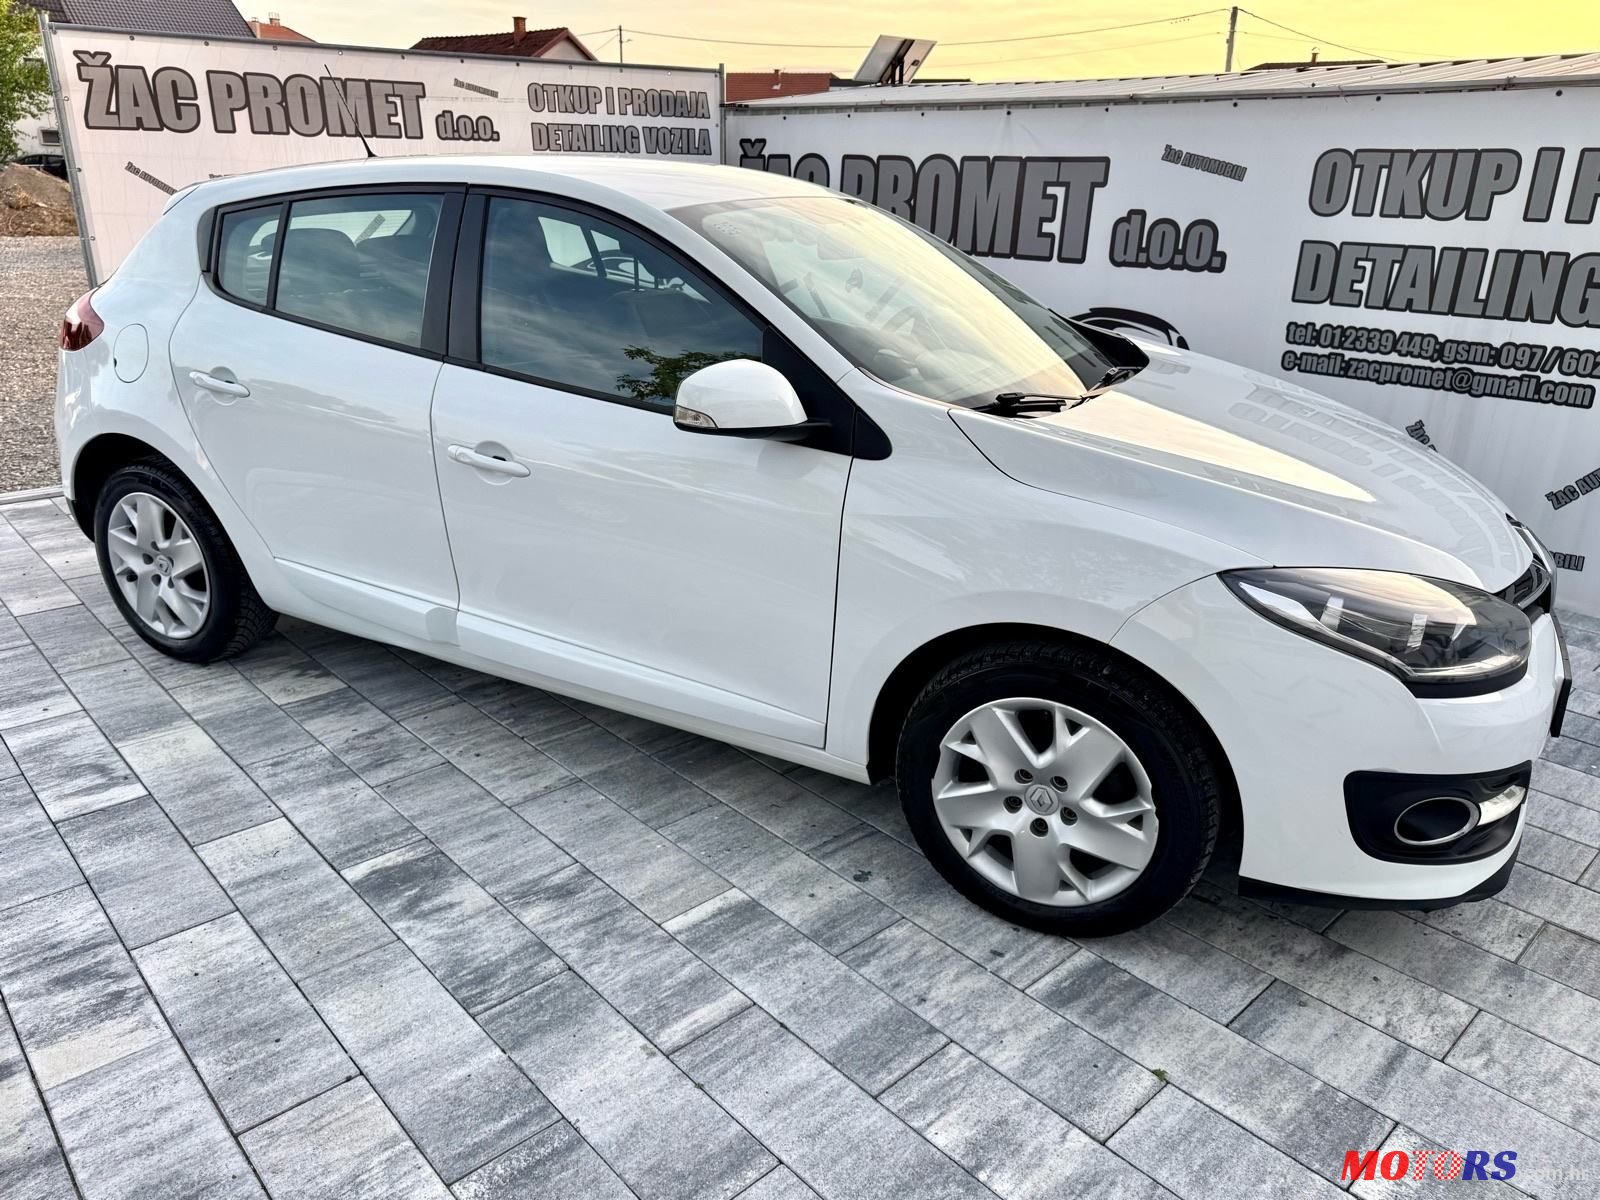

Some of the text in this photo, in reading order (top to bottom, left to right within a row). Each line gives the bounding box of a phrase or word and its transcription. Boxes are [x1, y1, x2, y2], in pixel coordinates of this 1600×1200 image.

[73, 50, 500, 141] ŽAC PROMET d.o.o.
[527, 82, 602, 114] OTKUP
[605, 87, 615, 115] I
[618, 87, 711, 119] PRODAJA
[531, 123, 712, 156] DETAILING VOZILA
[1161, 144, 1248, 182] ŽAC AUTOMOBILI
[1308, 147, 1522, 221] OTKUP
[1523, 147, 1565, 222] I
[1109, 208, 1227, 273] d.o.o.
[1291, 240, 1600, 329] DETAILING
[1286, 321, 1318, 347] tel:
[1440, 339, 1498, 367] gsm:
[1281, 350, 1596, 409] e-mail: zacpromet@gmail.com
[1545, 485, 1580, 510] ŽAC
[1550, 550, 1585, 571] BILI
